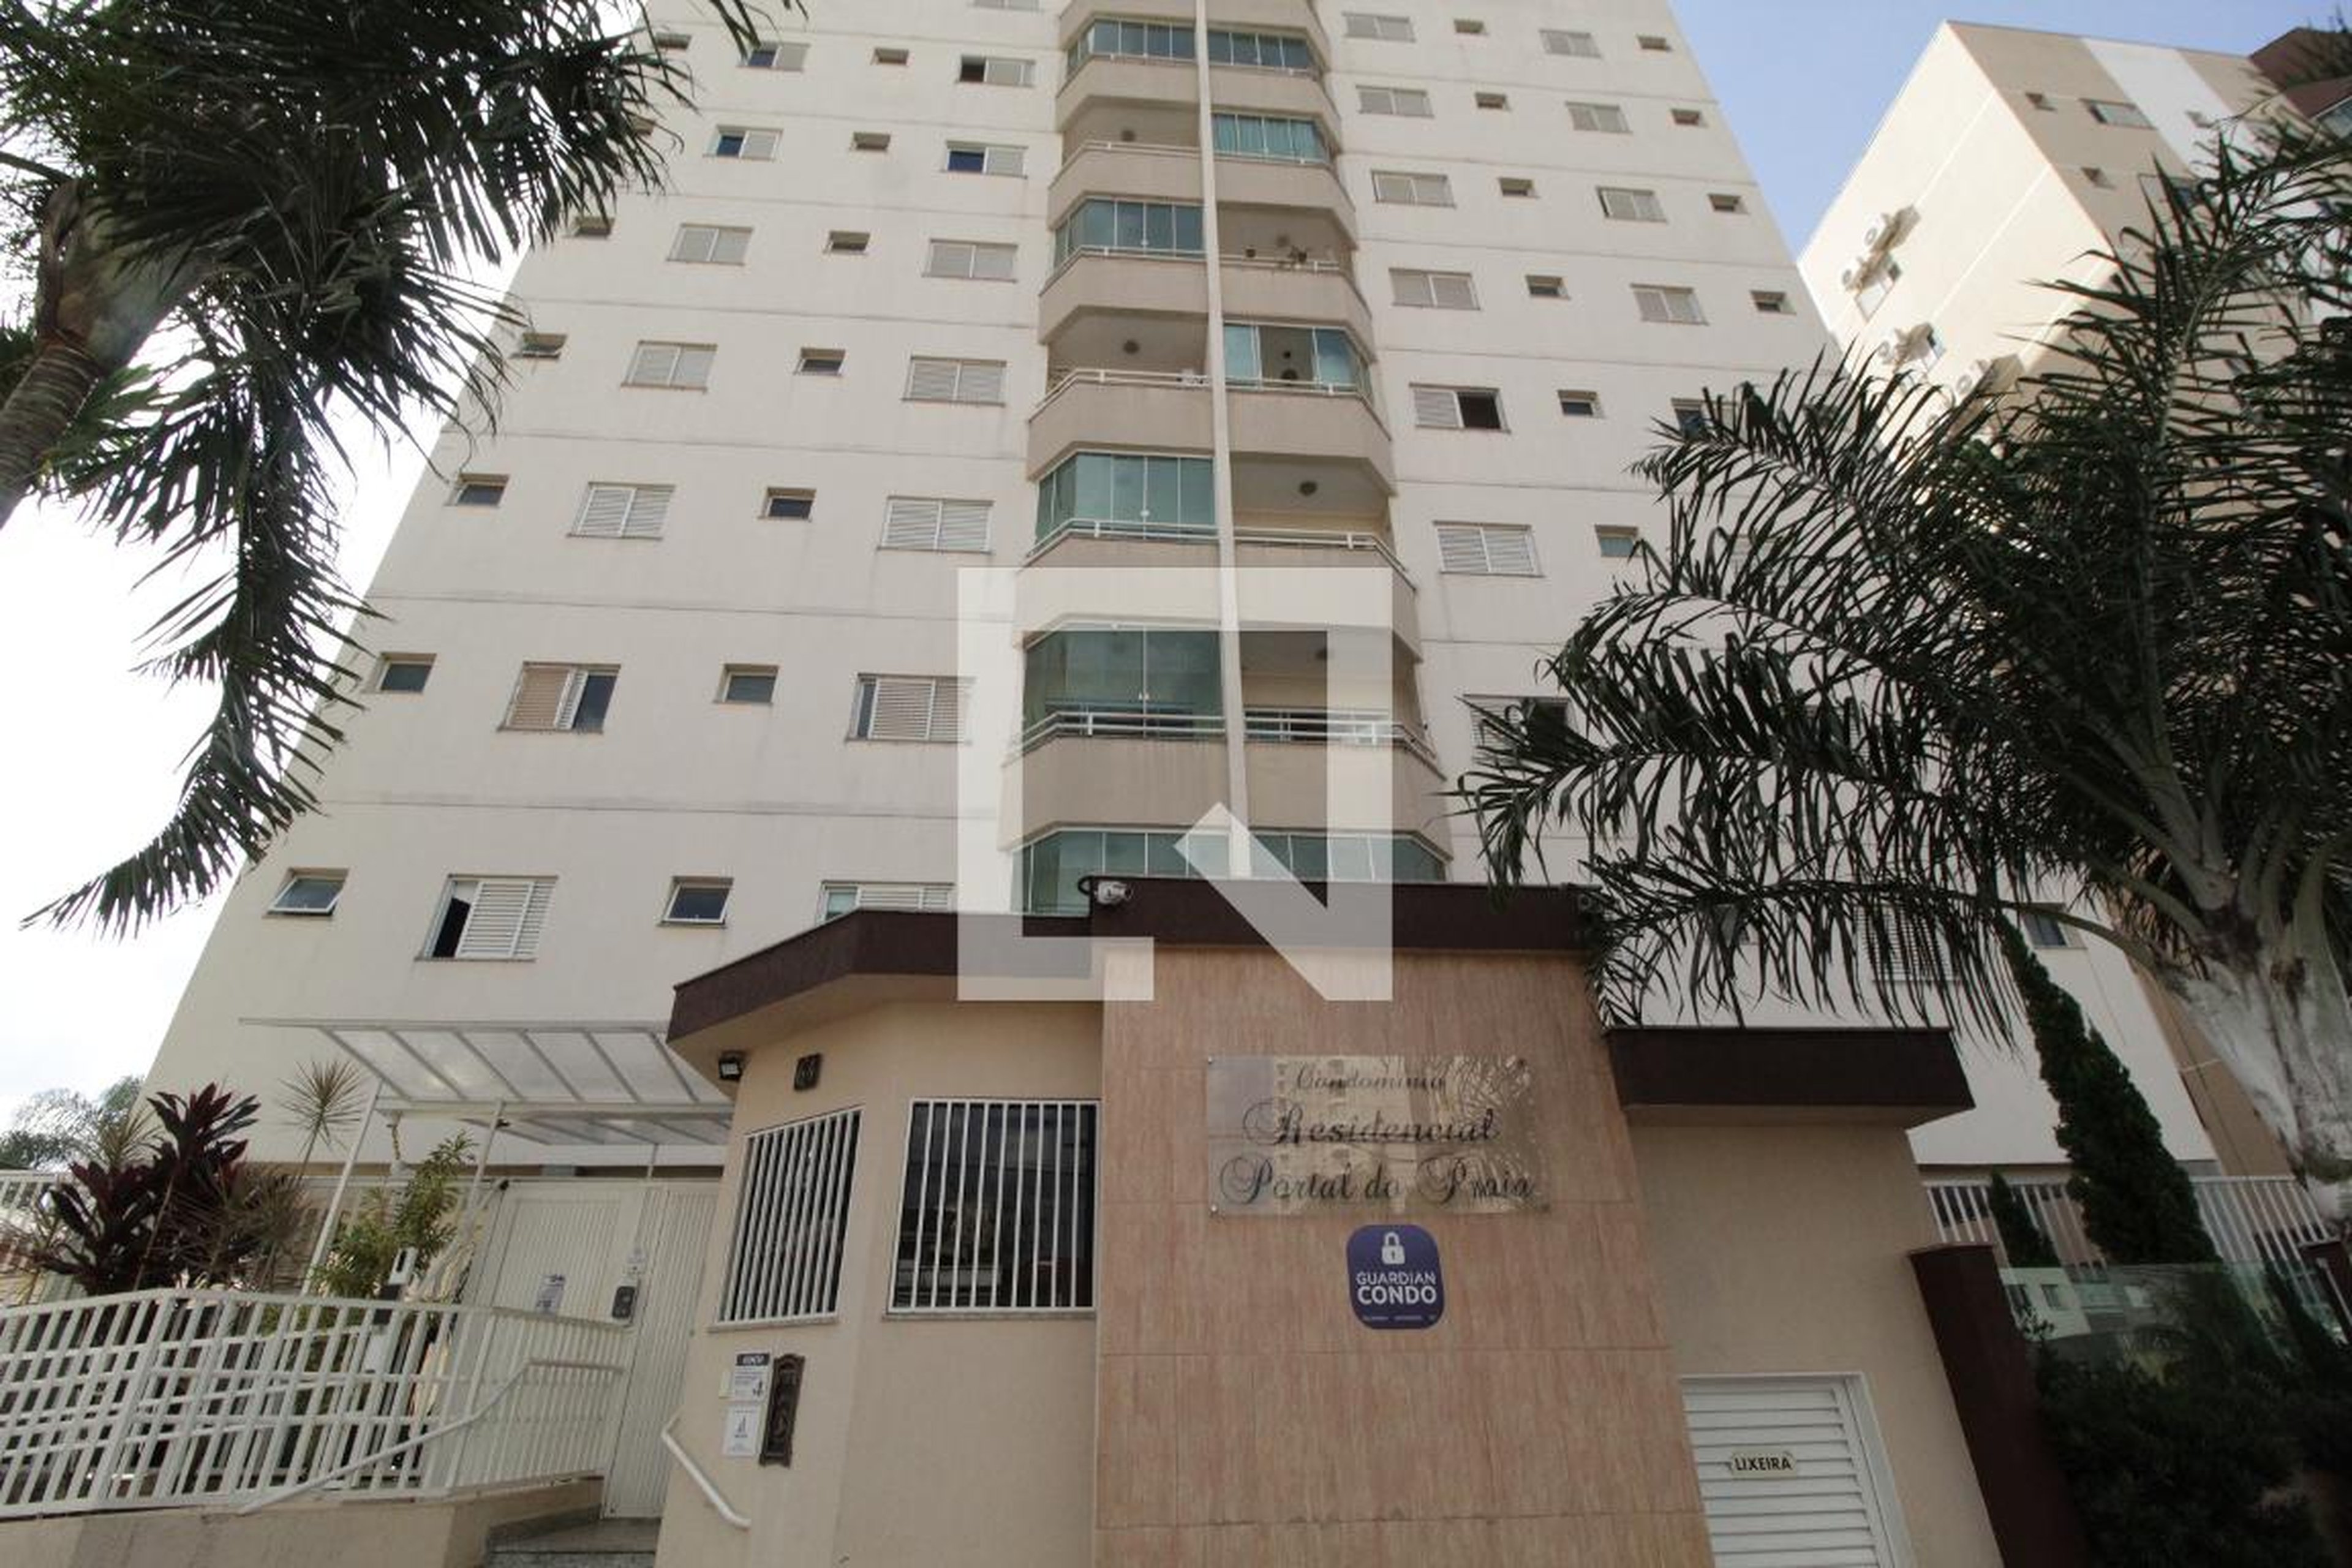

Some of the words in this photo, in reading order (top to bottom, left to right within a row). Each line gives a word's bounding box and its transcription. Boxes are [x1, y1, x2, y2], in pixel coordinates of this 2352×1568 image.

[1243, 1101, 1500, 1145] Residencial
[1221, 1156, 1353, 1205] Portal
[1355, 1271, 1436, 1286] GUARDIAN
[1357, 1285, 1437, 1305] CONDO
[1735, 1457, 1792, 1471] LIXEIRA
